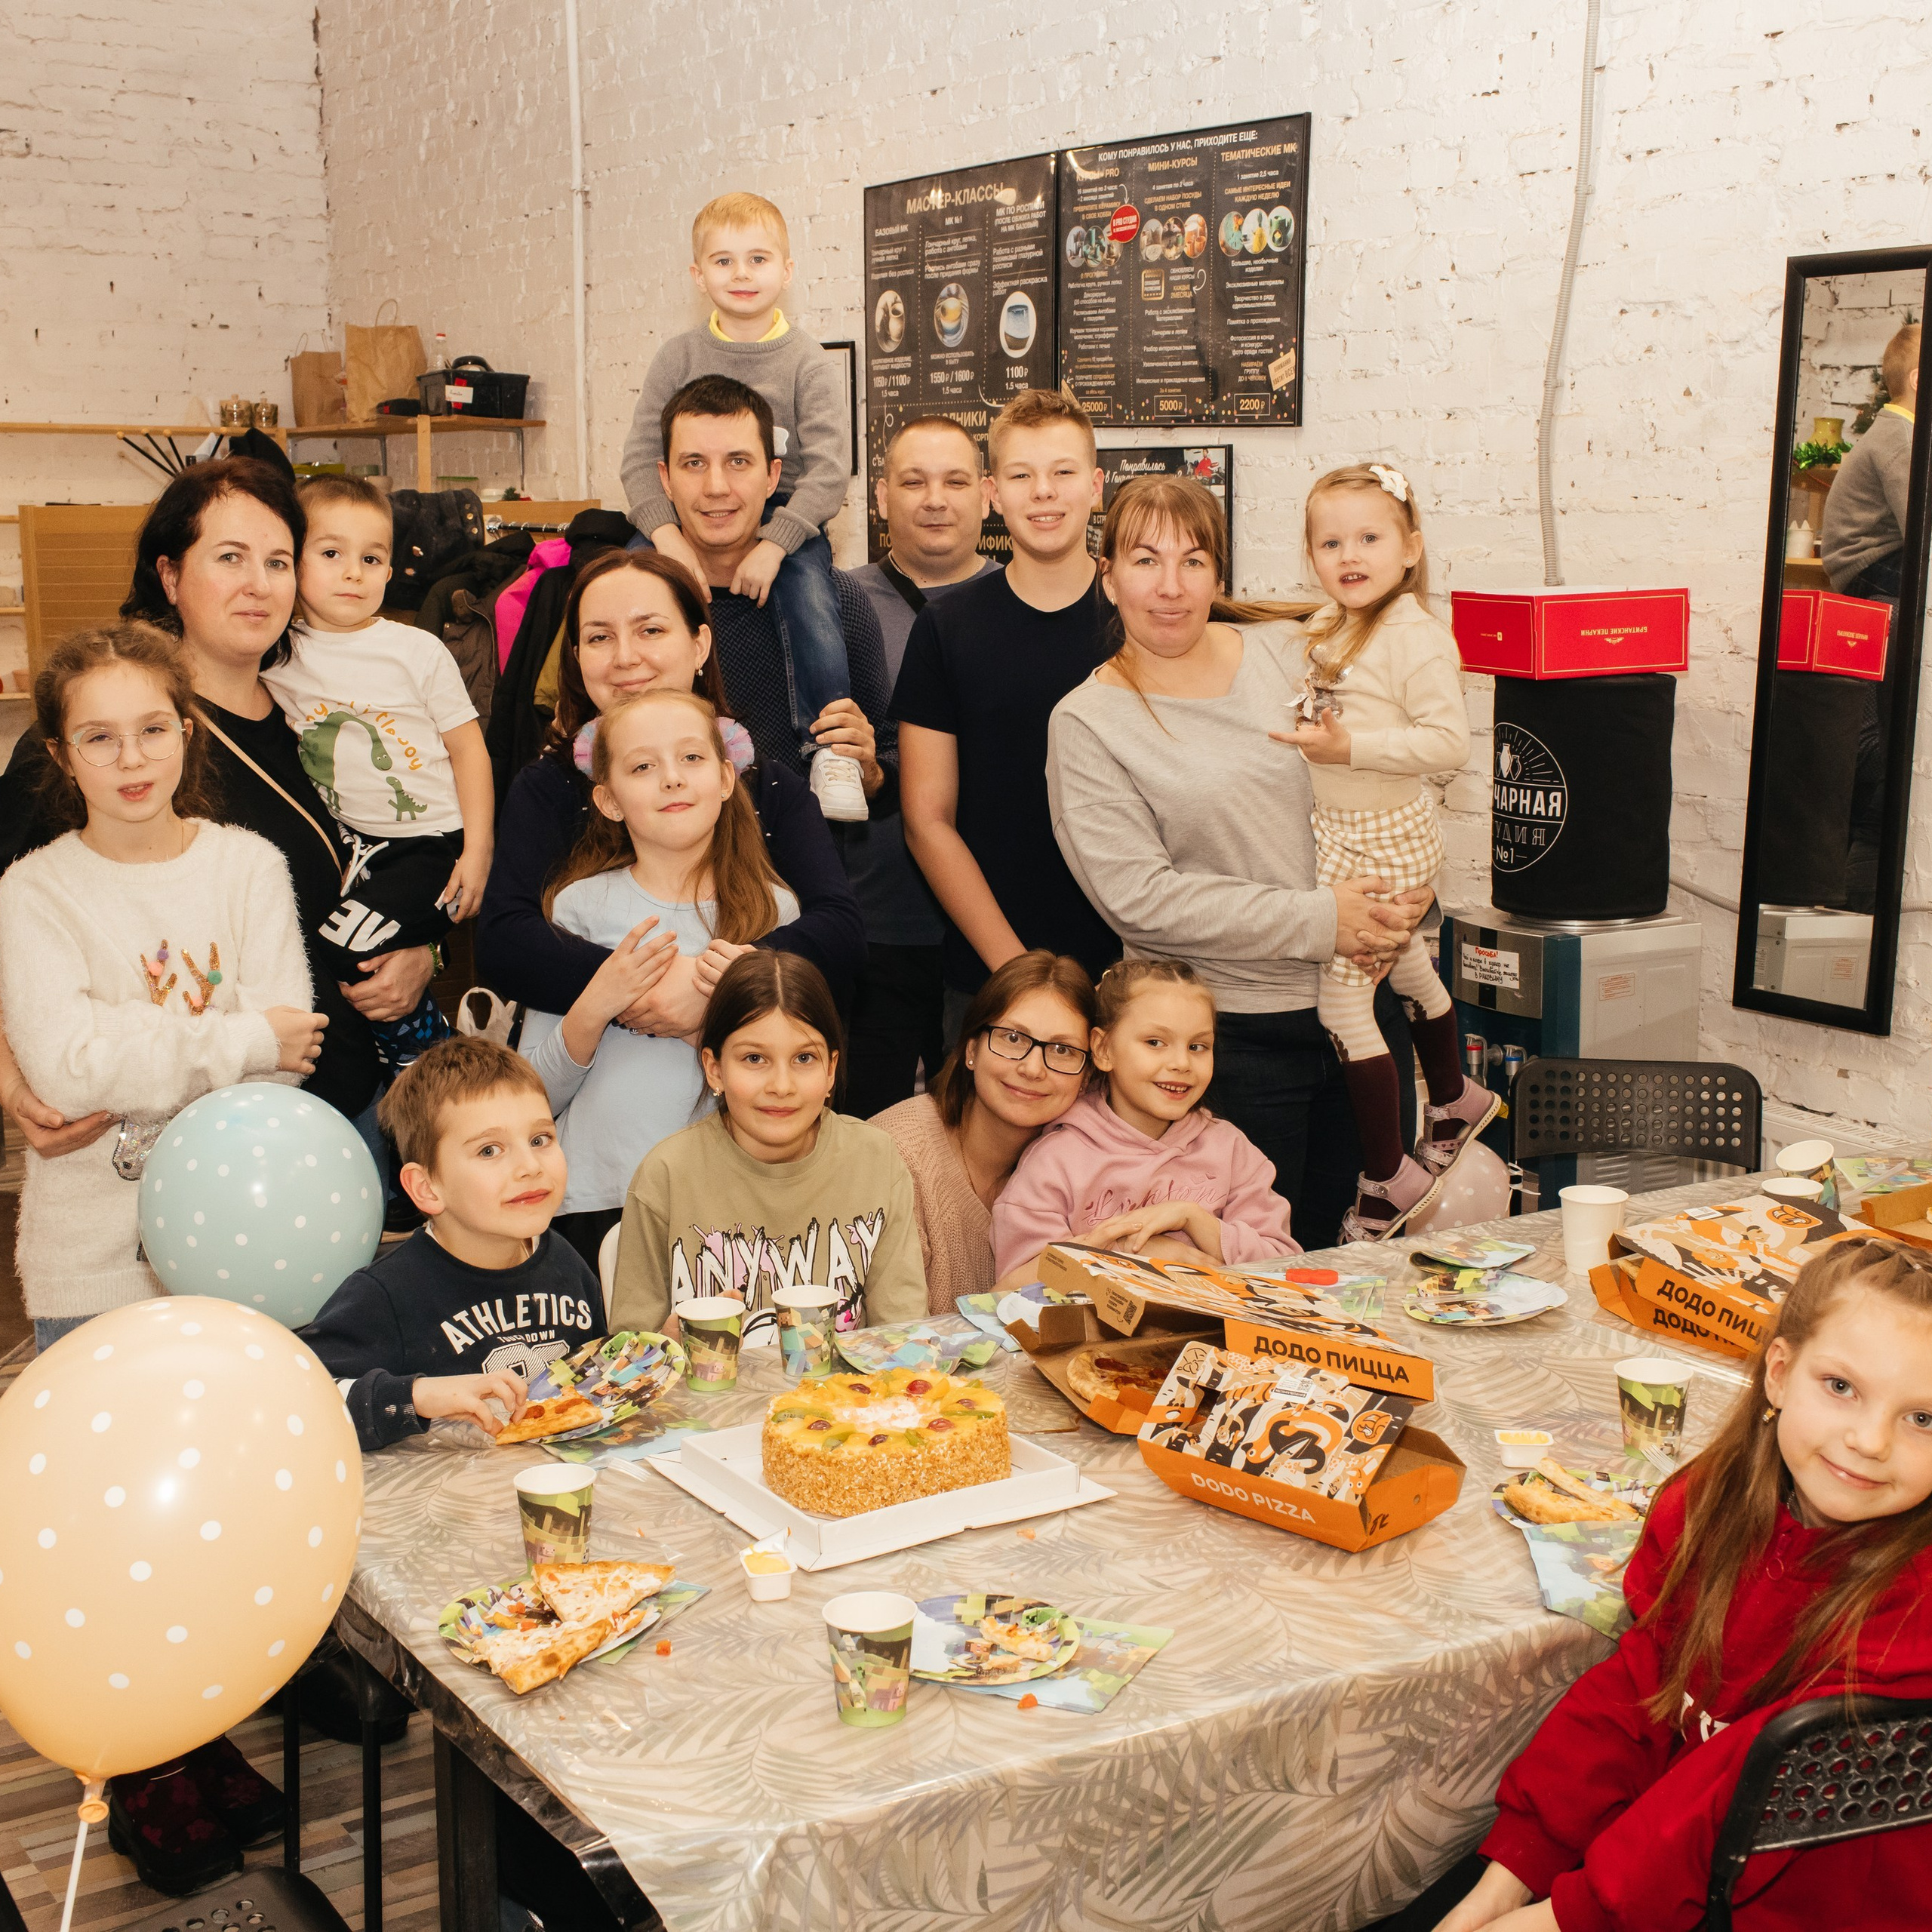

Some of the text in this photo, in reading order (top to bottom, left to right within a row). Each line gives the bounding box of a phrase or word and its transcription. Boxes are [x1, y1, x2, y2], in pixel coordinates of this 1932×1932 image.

[1099, 131, 1257, 162] КОМУ ПОНРАВИЛОСЬ У НАС, ПРИХОДИТЕ ЕЩЕ:
[1221, 143, 1297, 162] ТЕМАТИЧЕСКИЕ МК
[1149, 157, 1198, 172] МИНИ-КУРСЫ
[1243, 183, 1275, 193] ИНТЕРЕСНЫЕ
[1276, 181, 1291, 189] ИДЕИ
[906, 183, 1004, 214] МАСТЕР-КЛАССЫ
[1182, 191, 1201, 200] ПОСУДЫ
[1235, 192, 1279, 203] КАЖДУЮ НЕДЕЛЮ
[996, 207, 1005, 217] МК
[1006, 205, 1015, 215] ПО
[1031, 211, 1046, 221] РАБОТ
[946, 217, 953, 226] МК
[875, 226, 900, 237] БАЗОВЫЙ
[993, 248, 1010, 256] Работа
[1020, 275, 1048, 287] раскраска
[1120, 457, 1165, 475] Понравилось
[1105, 470, 1109, 483] в
[1580, 626, 1647, 636] БРИТАНСКИЕ ПЕКАРНИ
[1494, 783, 1562, 817] ЧАРНАЯ
[1497, 844, 1513, 863] №1
[671, 1207, 885, 1311] ANYWAY
[1657, 1279, 1715, 1317] ДОДО
[440, 1293, 592, 1355] ATHLETICS
[1253, 1335, 1321, 1365] ДОДО
[1326, 1351, 1410, 1384] ПИЦЦА
[1190, 1472, 1316, 1524] DODO PIZZA
